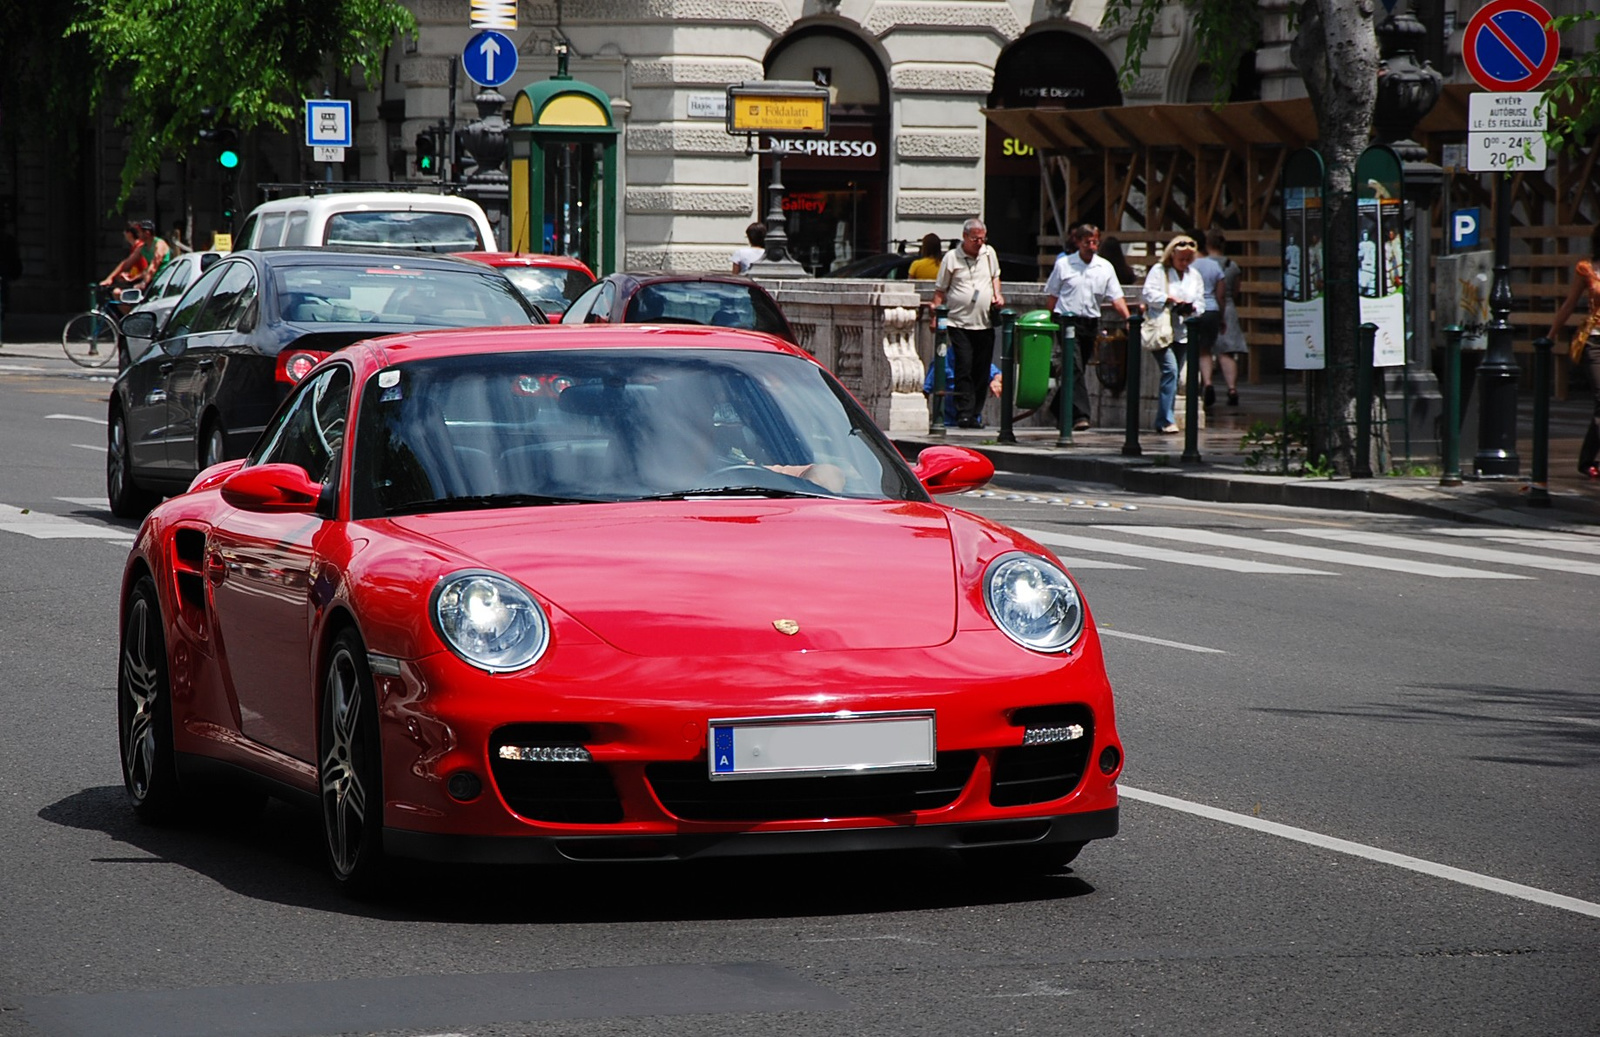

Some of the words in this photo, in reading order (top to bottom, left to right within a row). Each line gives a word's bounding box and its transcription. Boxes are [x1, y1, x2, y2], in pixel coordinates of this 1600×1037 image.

[1495, 96, 1522, 105] KIVÉVE
[1490, 107, 1527, 116] AUTÓBUSZ
[1488, 118, 1497, 127] ÉS
[1500, 119, 1543, 128] FELSZÁLLÁS
[771, 139, 877, 157] NESPRESSO
[1490, 152, 1507, 165] 20
[781, 198, 826, 214] Gallery
[1455, 215, 1476, 242] P
[720, 755, 729, 766] A
